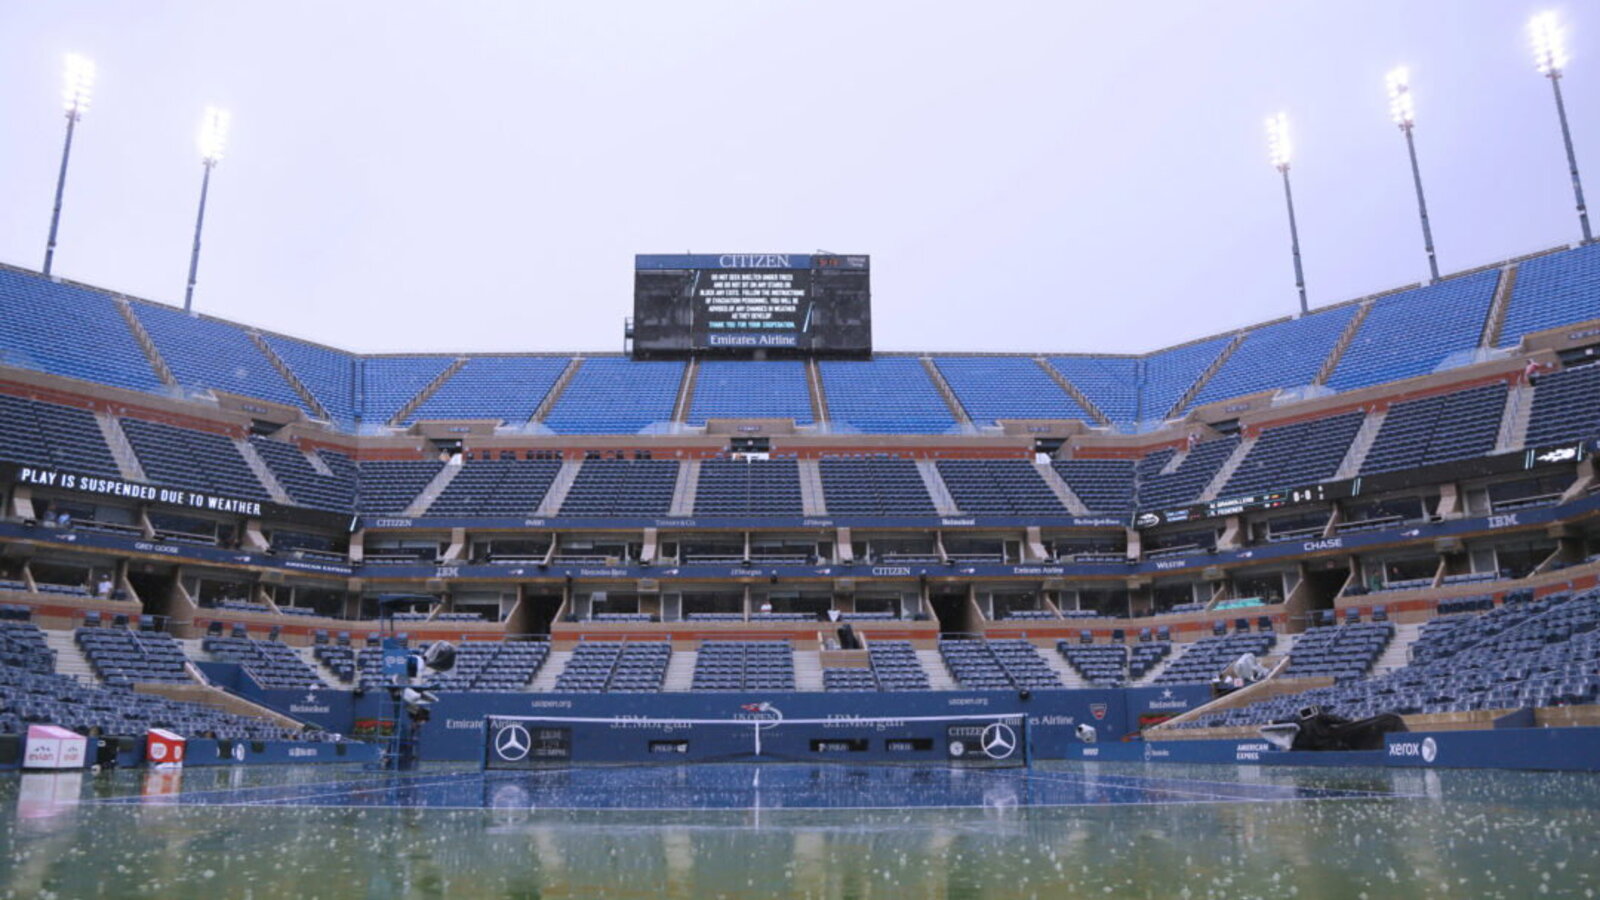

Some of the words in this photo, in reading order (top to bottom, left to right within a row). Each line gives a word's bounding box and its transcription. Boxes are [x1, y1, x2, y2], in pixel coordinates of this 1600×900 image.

[719, 254, 791, 269] CITIZEN
[710, 334, 756, 345] Emirates
[760, 334, 796, 345] Airline
[21, 468, 57, 485] PLAY
[61, 474, 75, 488] IS
[80, 478, 156, 500] SUSPENDED
[160, 489, 184, 505] DUE
[189, 494, 204, 506] TO
[208, 496, 262, 516] WEATHER
[376, 518, 412, 527] CITIZEN
[1488, 513, 1519, 528] IBM
[1304, 538, 1342, 551] CHASE
[285, 561, 321, 570] AMERICAN
[872, 566, 911, 576] CITIZEN
[436, 567, 459, 578] IBM
[290, 704, 330, 714] Heineken
[1150, 700, 1188, 709] Heineken
[1041, 716, 1074, 726] Airline
[1388, 742, 1420, 756] xerox
